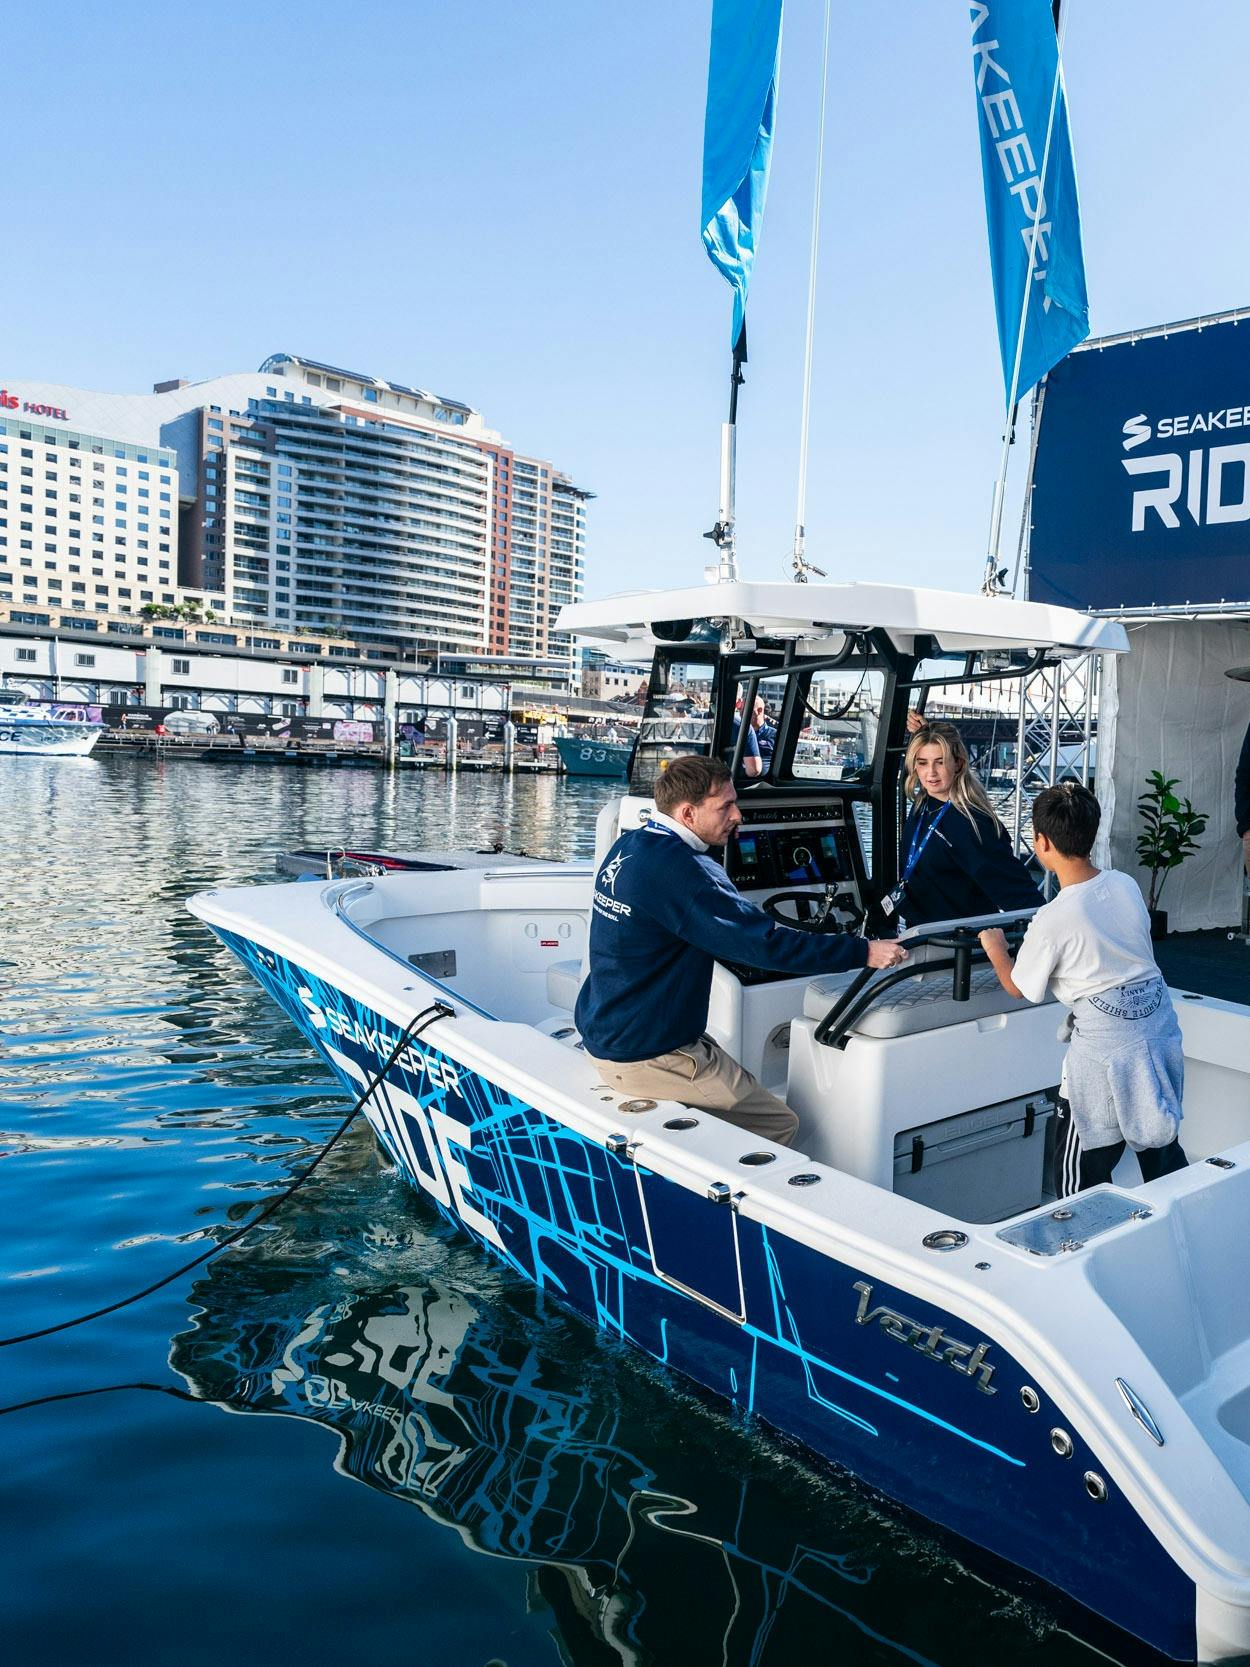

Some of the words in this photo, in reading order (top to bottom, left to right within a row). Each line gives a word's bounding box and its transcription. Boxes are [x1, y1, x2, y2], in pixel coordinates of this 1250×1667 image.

[23, 402, 70, 421] HOTEL
[580, 748, 607, 762] 83
[1120, 989, 1146, 998] MANLY
[1092, 996, 1128, 1017] SHIELD
[326, 1006, 464, 1098] SEAKEEPER
